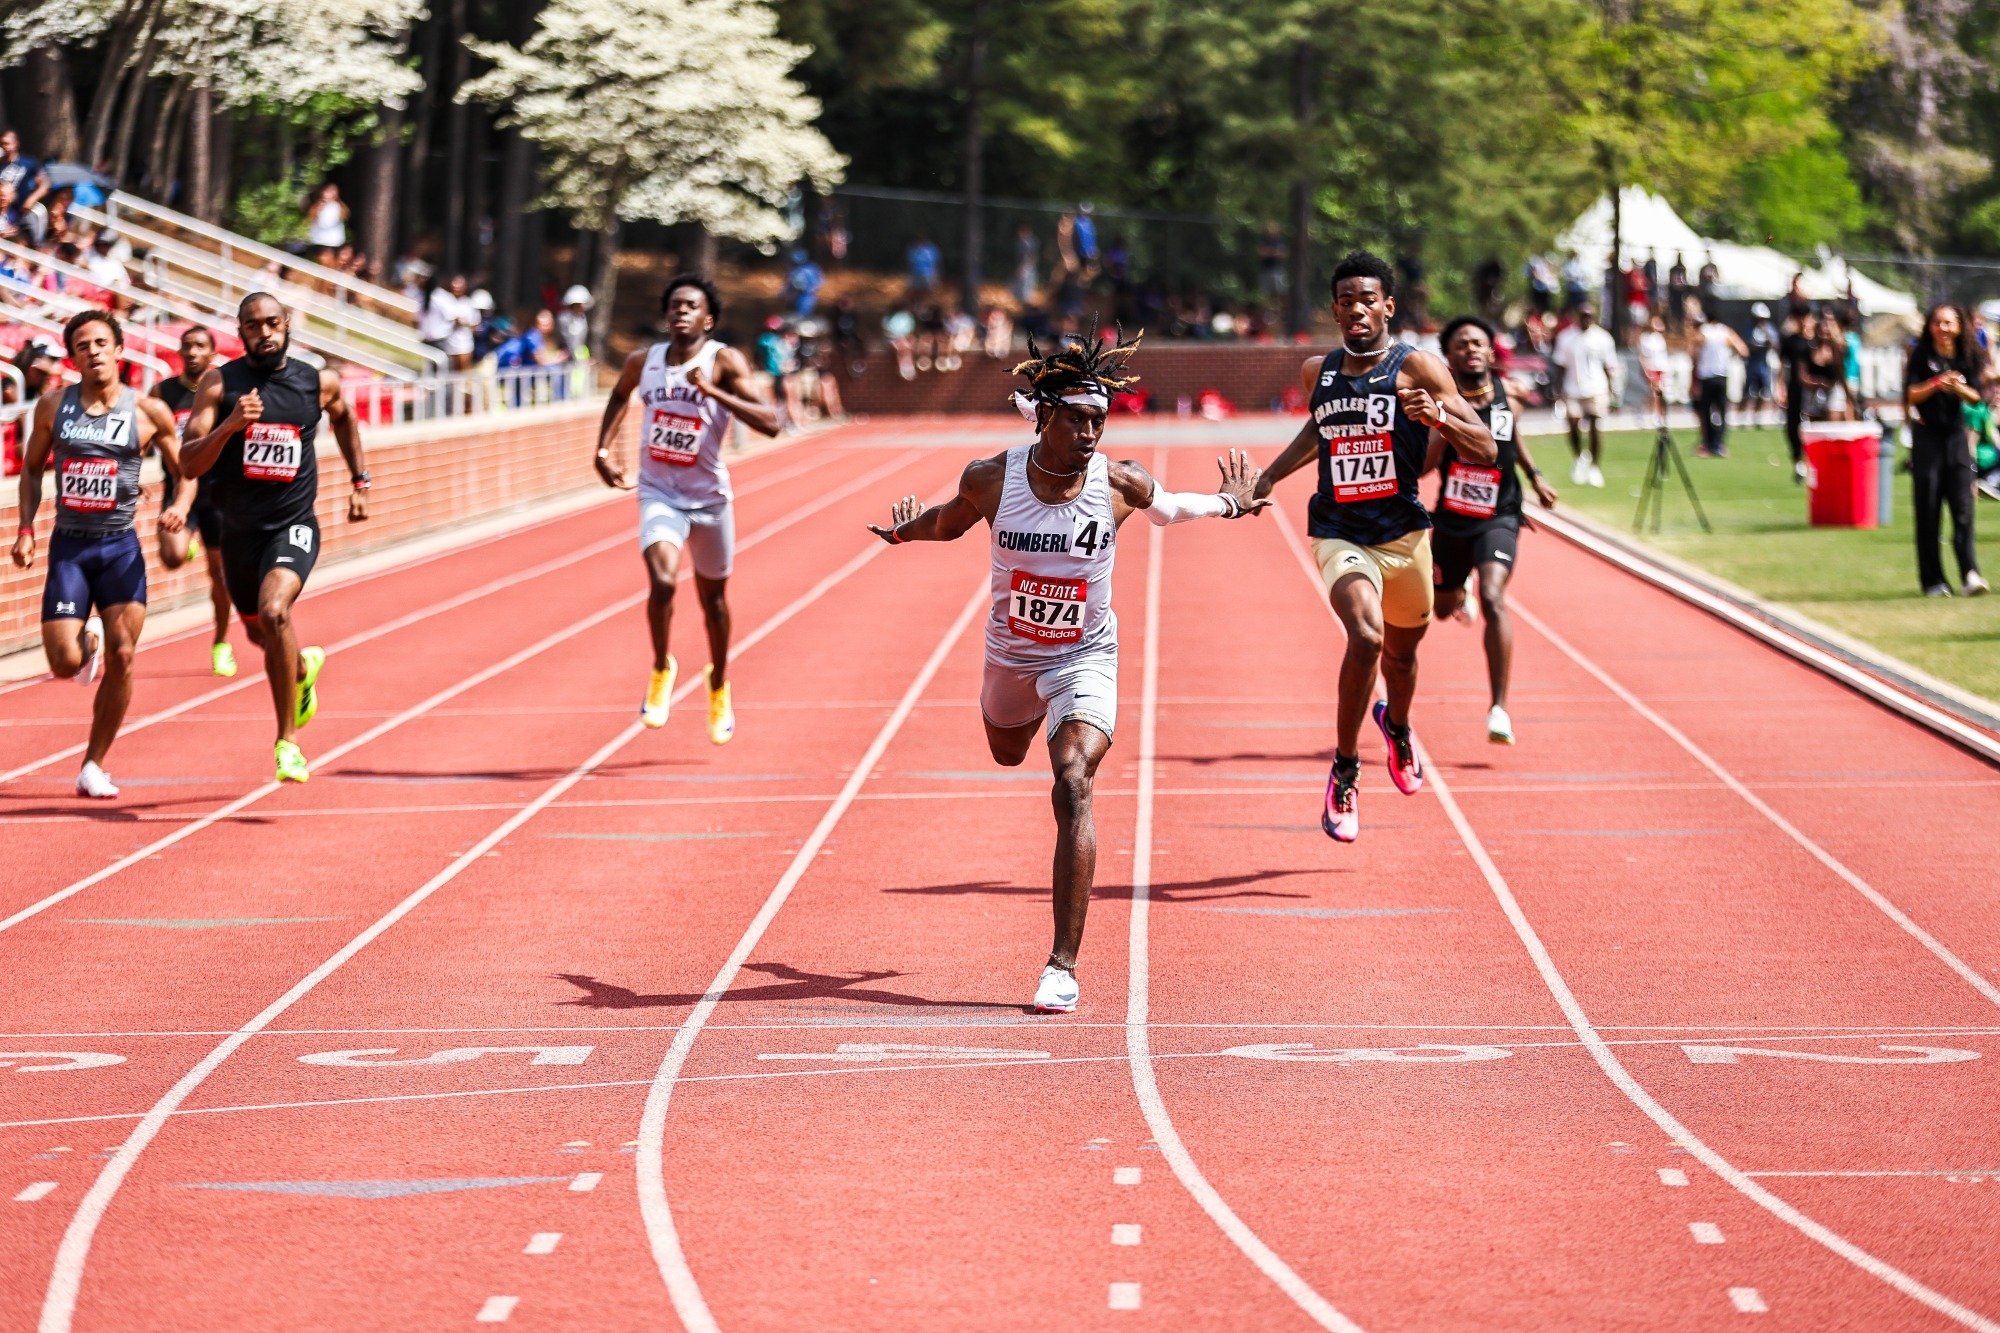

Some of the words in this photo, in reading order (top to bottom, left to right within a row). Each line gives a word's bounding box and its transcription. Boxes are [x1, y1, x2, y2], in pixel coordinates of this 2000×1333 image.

[1314, 397, 1370, 425] CHARLEST
[1371, 397, 1390, 428] 3
[60, 418, 107, 442] Seaha
[111, 418, 125, 441] 7
[267, 428, 295, 443] STATE
[1496, 415, 1507, 437] 2
[653, 427, 696, 451] 2462
[1337, 442, 1351, 455] NC
[1352, 439, 1384, 454] STATE
[247, 443, 294, 465] 2781
[82, 462, 110, 477] STATE
[1336, 455, 1389, 482] 1747
[65, 475, 112, 498] 2846
[1359, 482, 1394, 494] adidas
[998, 530, 1111, 553] CUMBERLS
[1074, 520, 1099, 557] 4
[1019, 578, 1038, 594] NC
[1039, 583, 1079, 600] STATE
[1015, 595, 1080, 626] 1874
[1037, 629, 1077, 640] adidas
